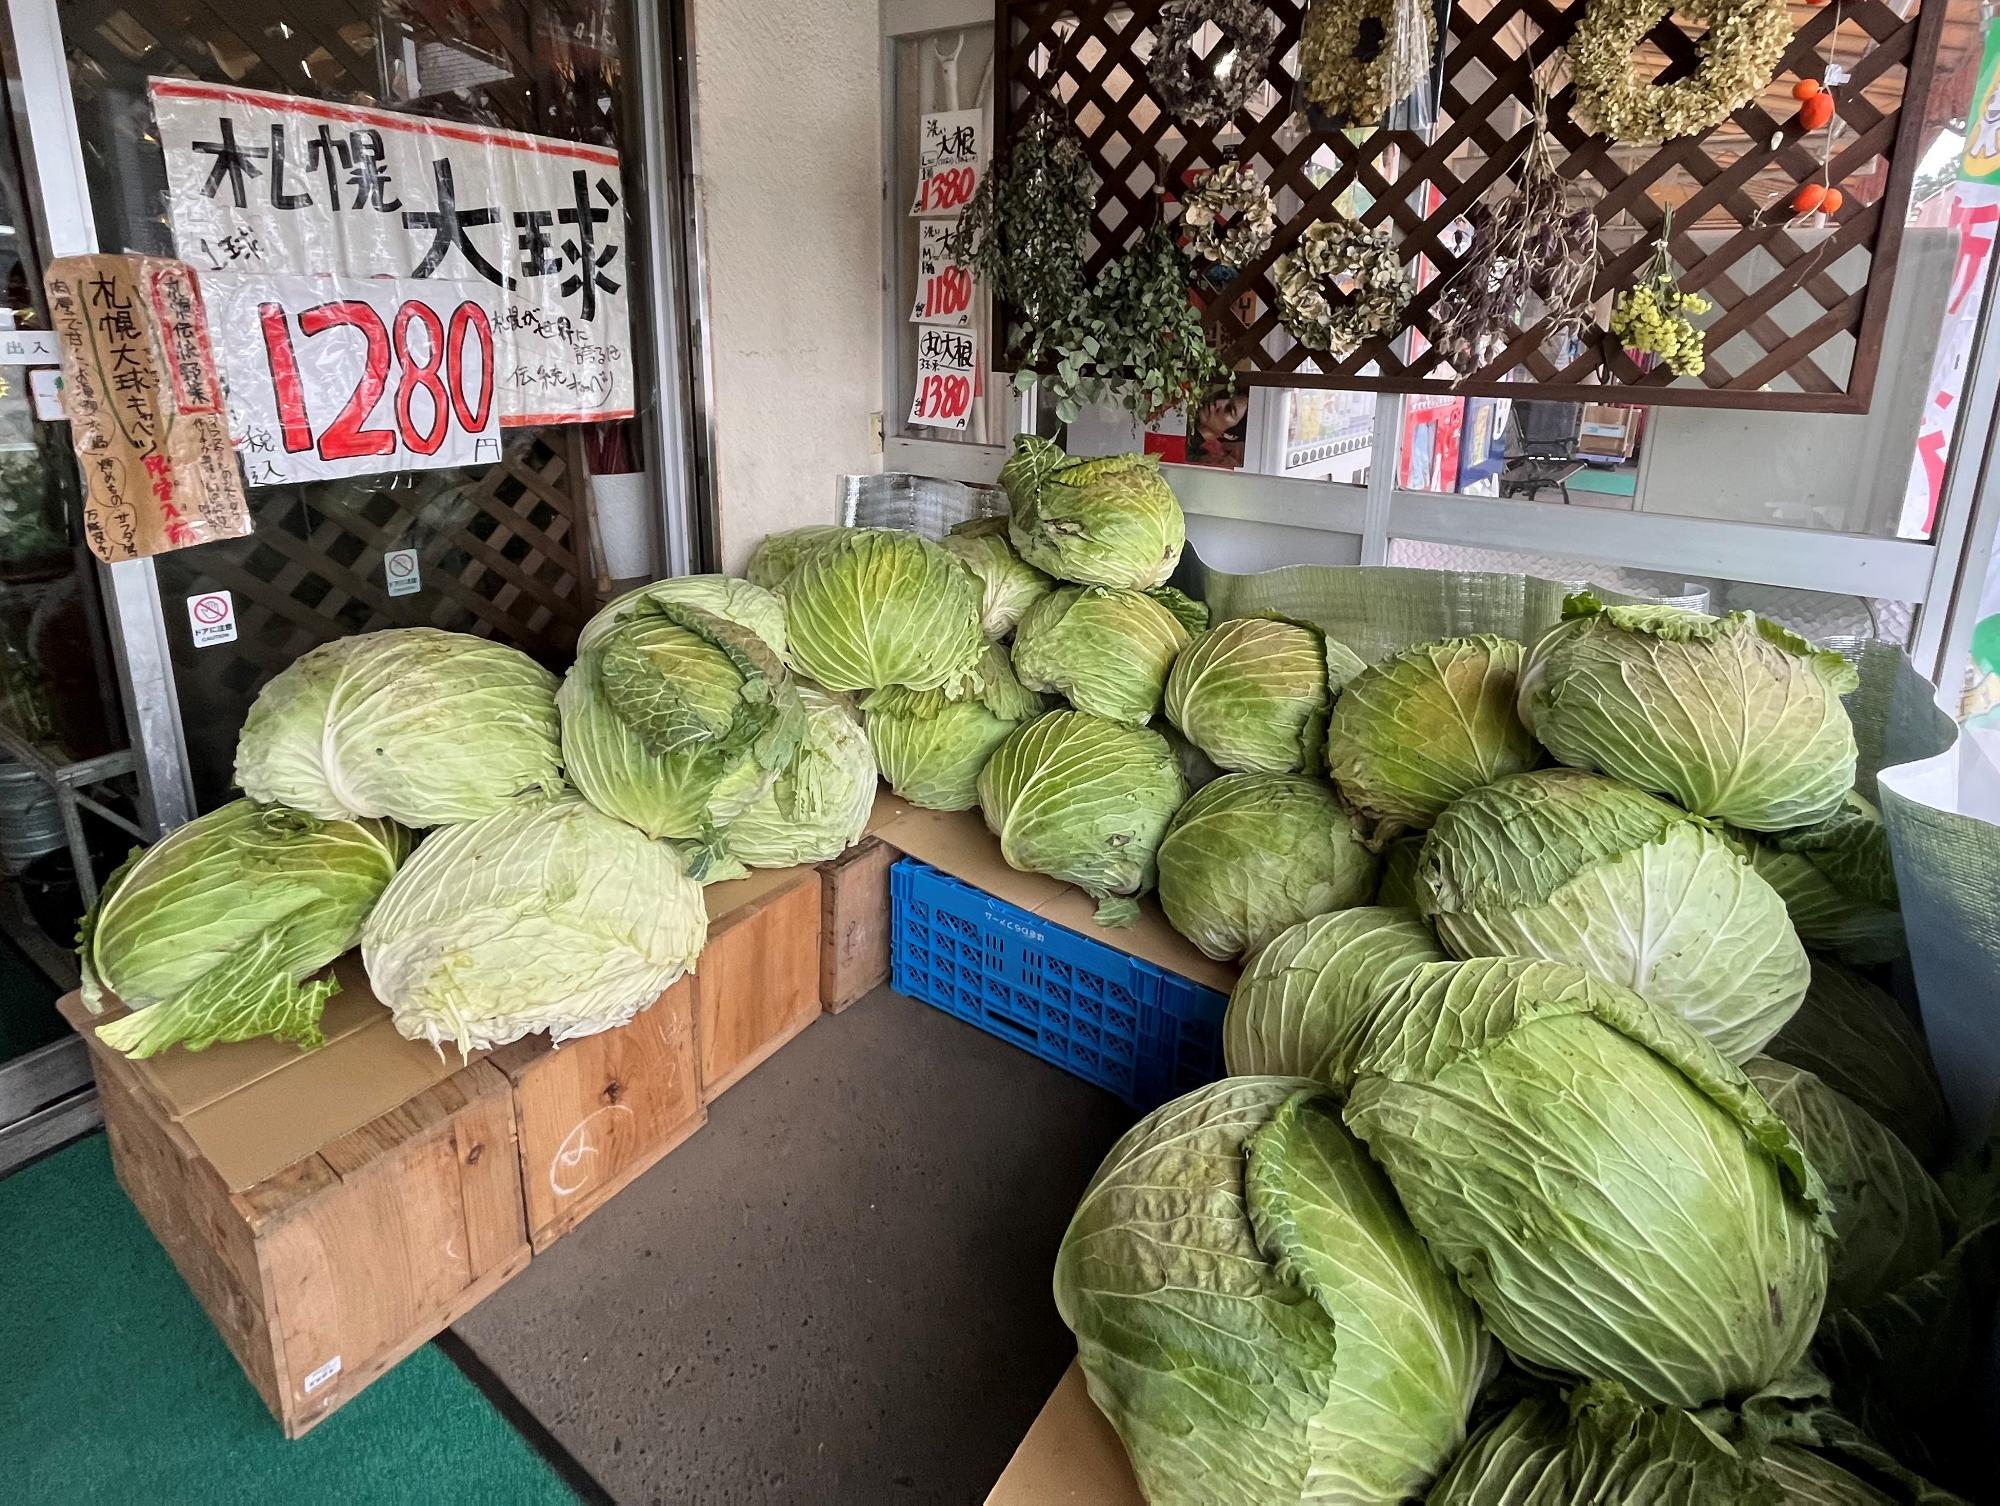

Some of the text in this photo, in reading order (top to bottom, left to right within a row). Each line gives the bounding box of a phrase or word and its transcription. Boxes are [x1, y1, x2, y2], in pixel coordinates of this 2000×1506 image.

[921, 166, 976, 212] 1380
[925, 265, 972, 318] 1180
[257, 299, 495, 462] 1280
[918, 374, 970, 418] 1380
[475, 438, 501, 463] 円
[195, 623, 233, 636] ドアに注意
